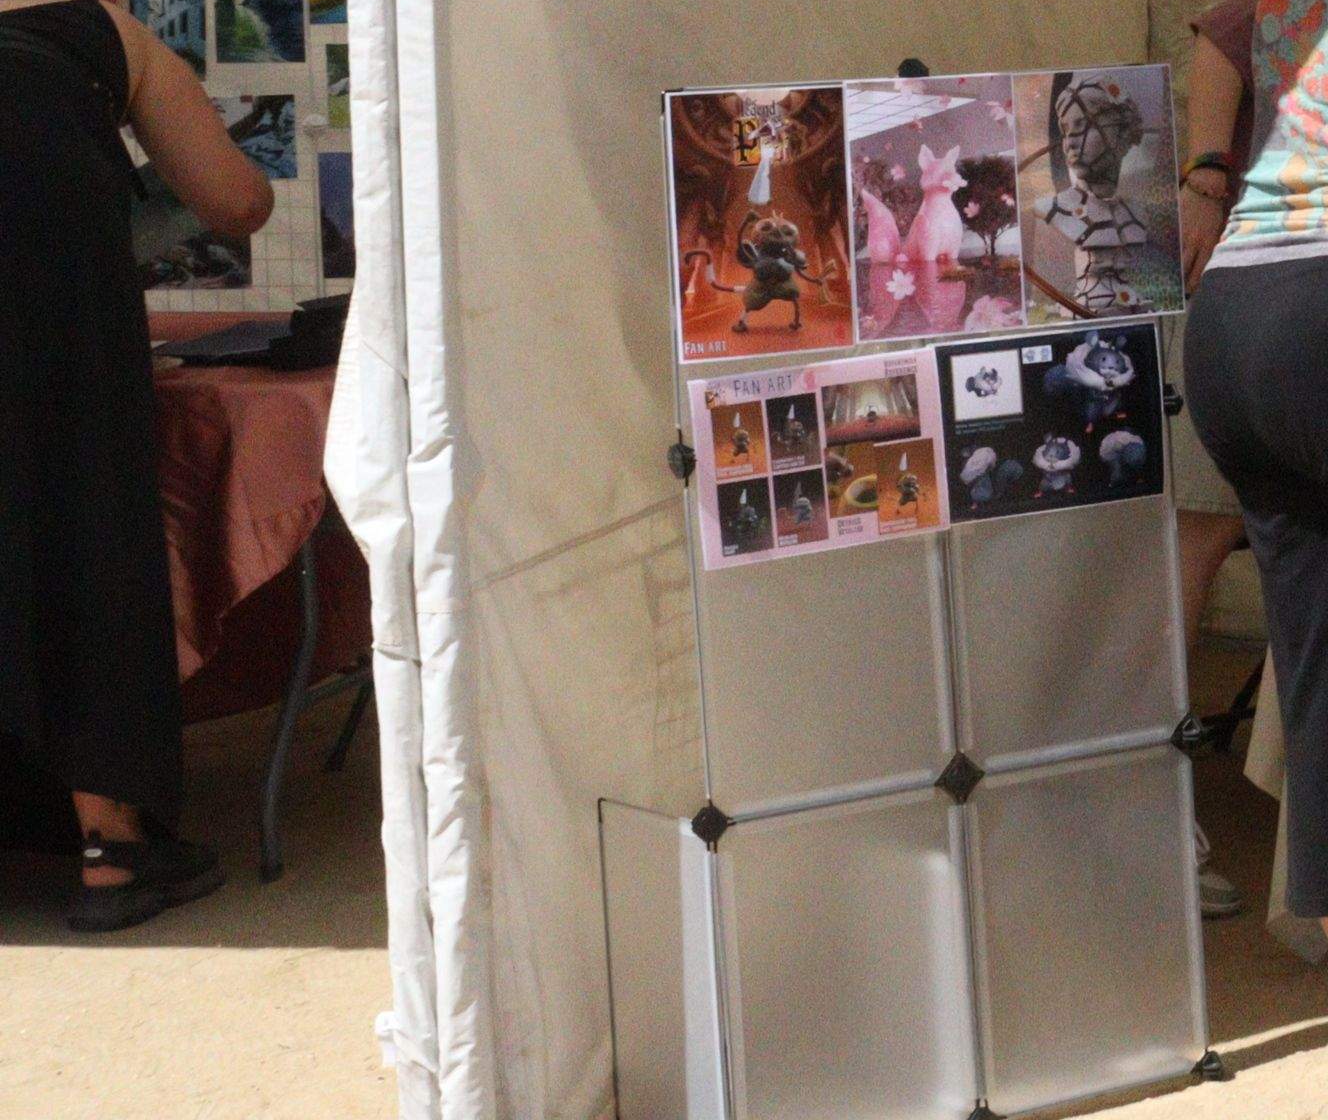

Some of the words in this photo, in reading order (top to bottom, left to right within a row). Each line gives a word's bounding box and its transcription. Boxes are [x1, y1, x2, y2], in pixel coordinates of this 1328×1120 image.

[684, 342, 704, 354] FAN
[709, 340, 727, 352] ART
[733, 379, 760, 397] FAN
[767, 375, 792, 393] ART
